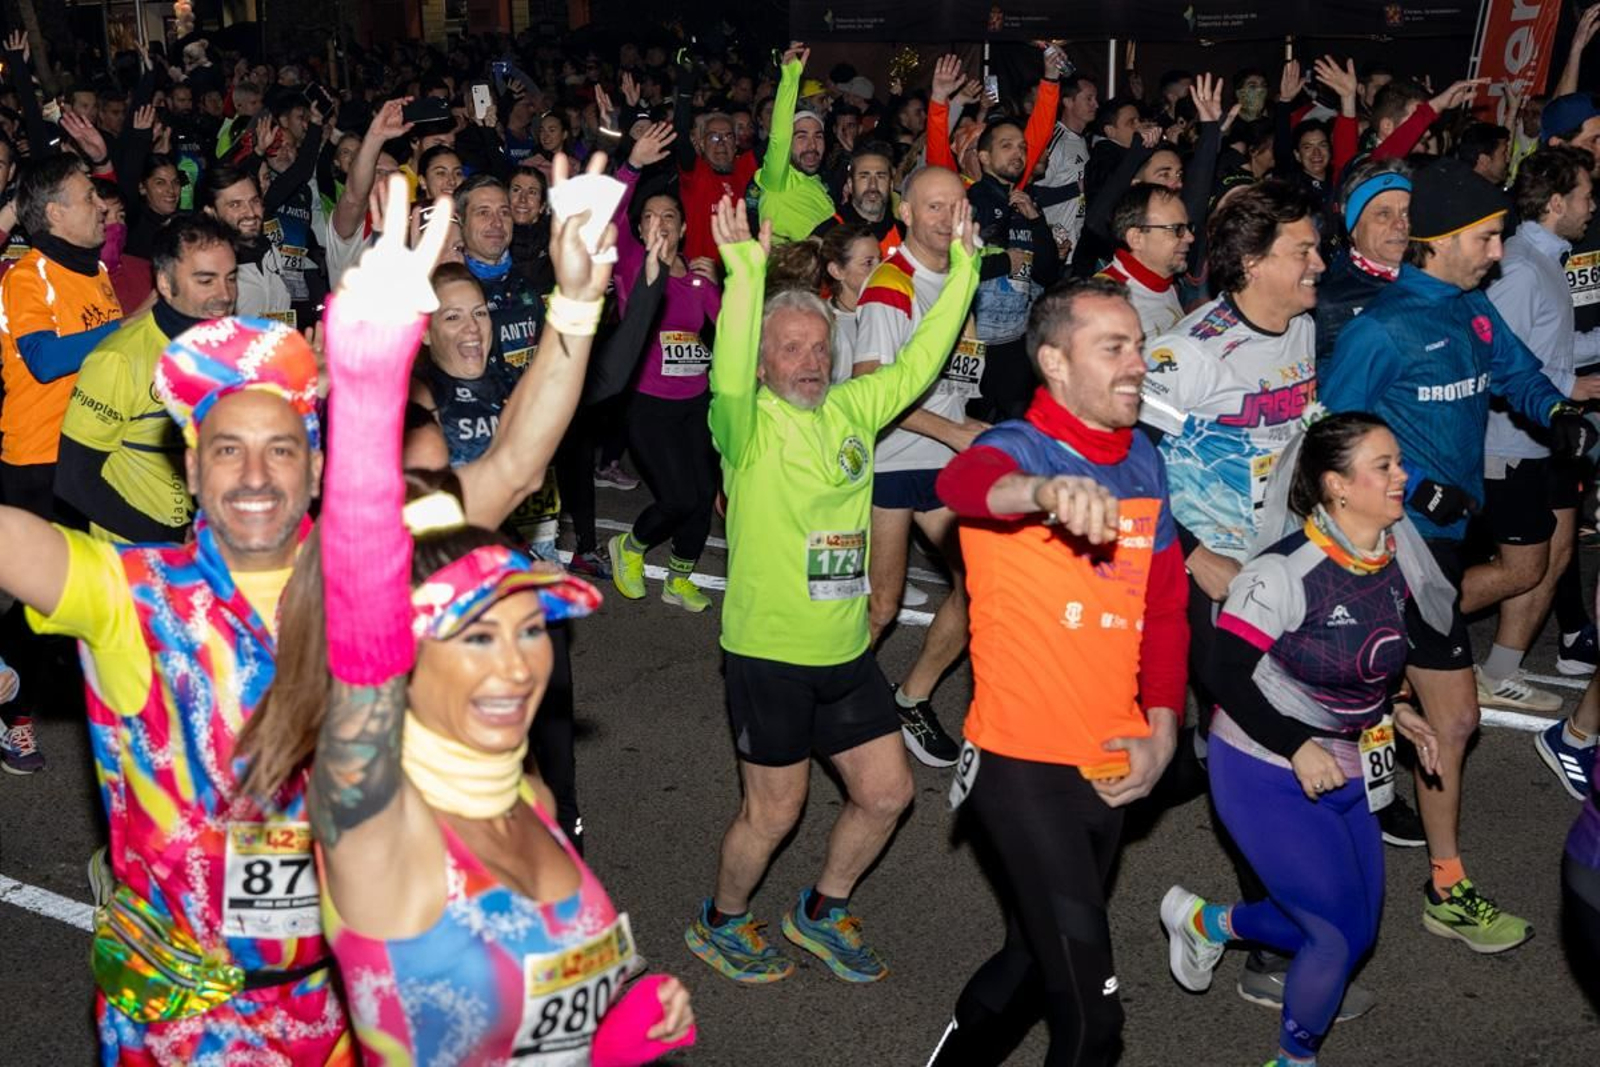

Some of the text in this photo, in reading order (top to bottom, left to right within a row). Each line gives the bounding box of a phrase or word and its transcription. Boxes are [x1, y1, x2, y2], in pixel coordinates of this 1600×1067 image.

[284, 256, 301, 268] 781
[265, 830, 296, 850] 42
[242, 859, 311, 896] 87
